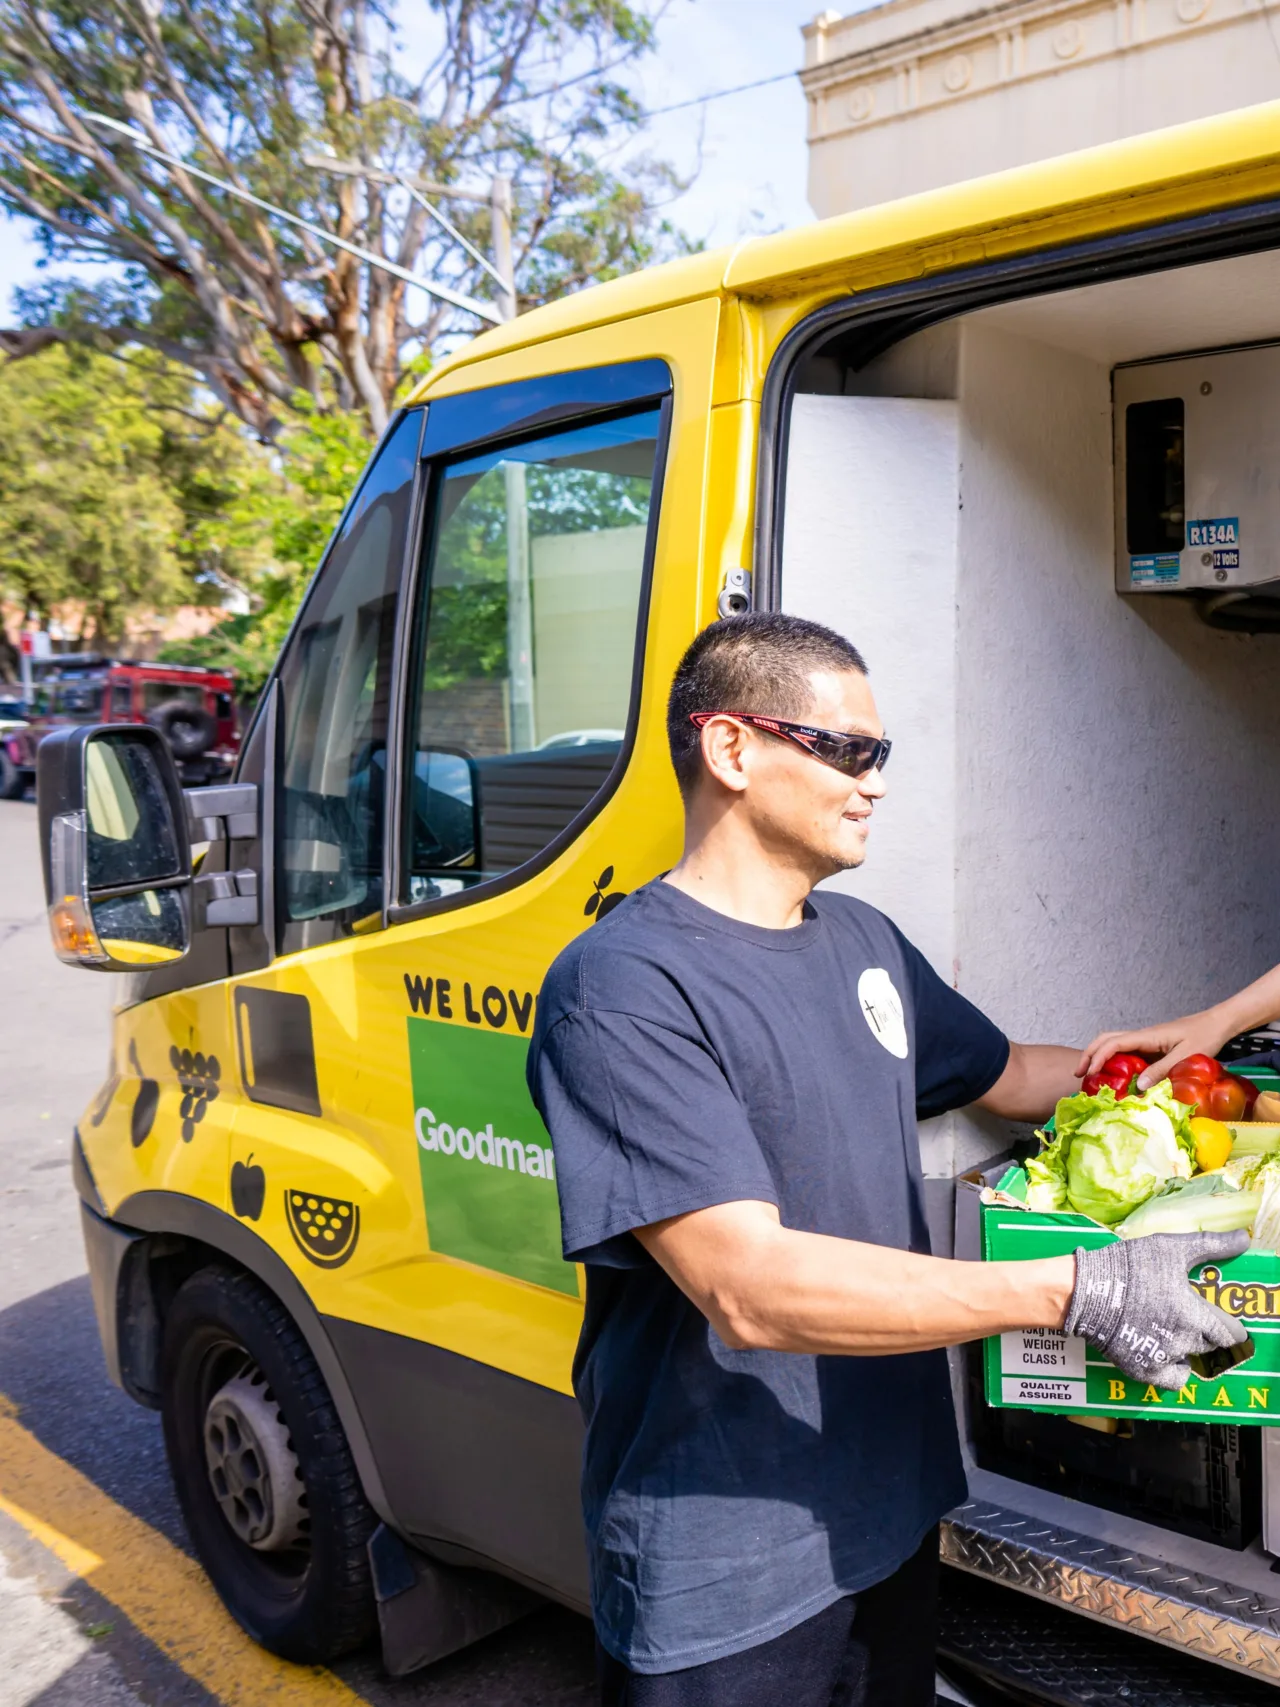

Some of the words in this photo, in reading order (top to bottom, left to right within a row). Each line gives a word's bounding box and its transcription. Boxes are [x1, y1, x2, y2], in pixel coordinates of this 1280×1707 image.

[1190, 525, 1236, 546] R134A
[1214, 554, 1220, 566] 12
[1222, 552, 1238, 566] Volts
[404, 973, 453, 1019] WE
[464, 982, 540, 1033] LOV
[1023, 1338, 1066, 1351] WEIGHT
[1022, 1352, 1057, 1365] CLASS
[1060, 1356, 1066, 1365] 1
[1020, 1382, 1070, 1391] QUALITY
[1018, 1391, 1072, 1400] ASSURED
